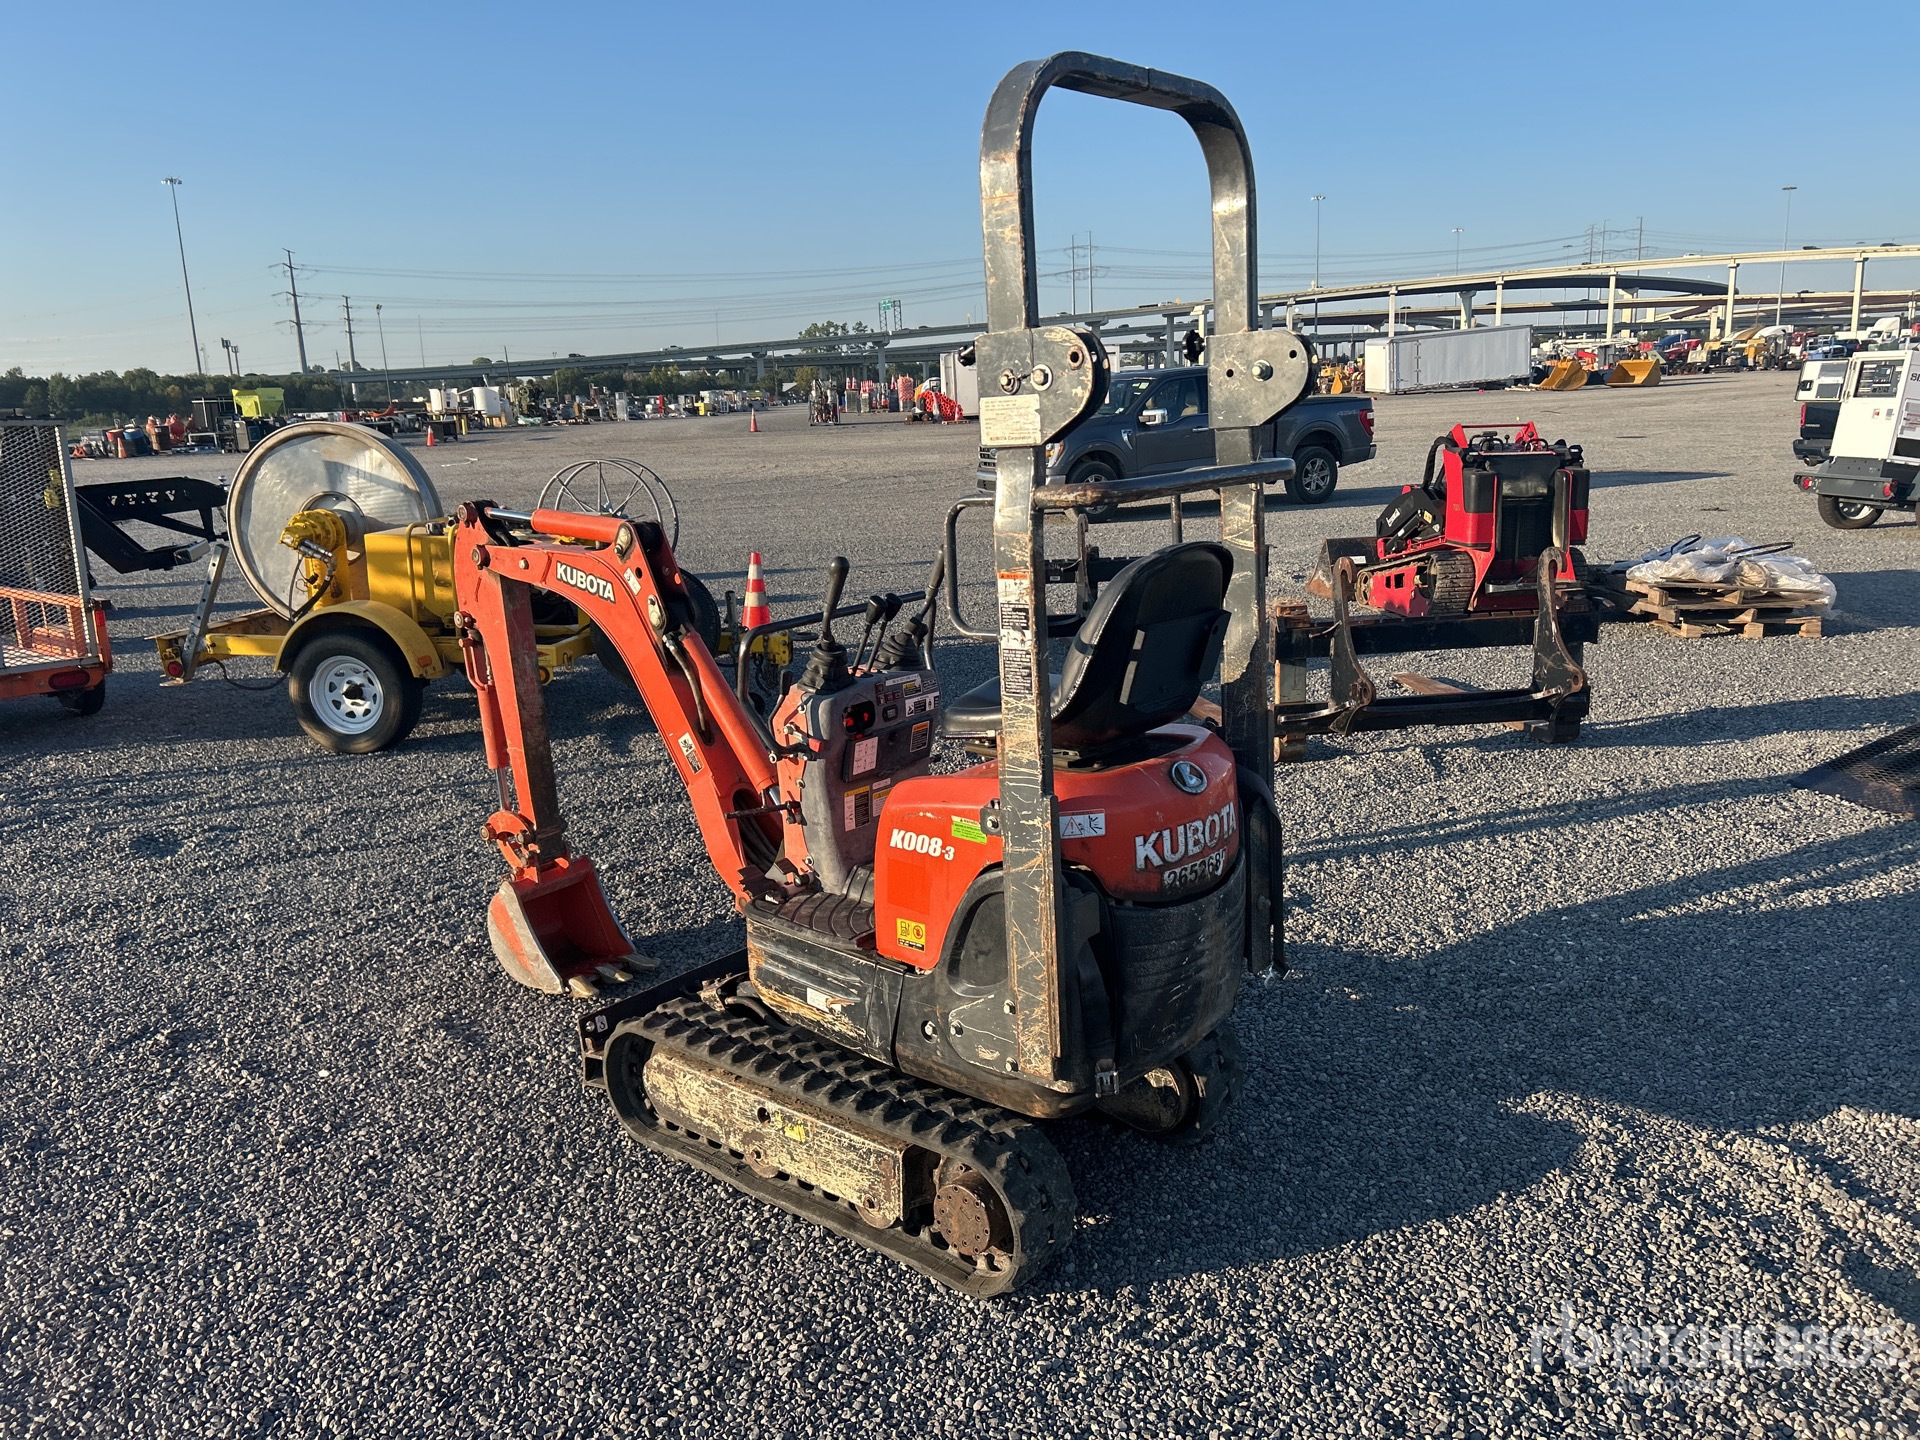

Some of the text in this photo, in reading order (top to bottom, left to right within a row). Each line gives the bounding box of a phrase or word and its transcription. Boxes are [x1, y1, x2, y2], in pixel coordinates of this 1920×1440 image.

[556, 561, 616, 604] KUBOTA
[889, 828, 955, 861] K008-3
[1135, 801, 1236, 869] KUBOTA
